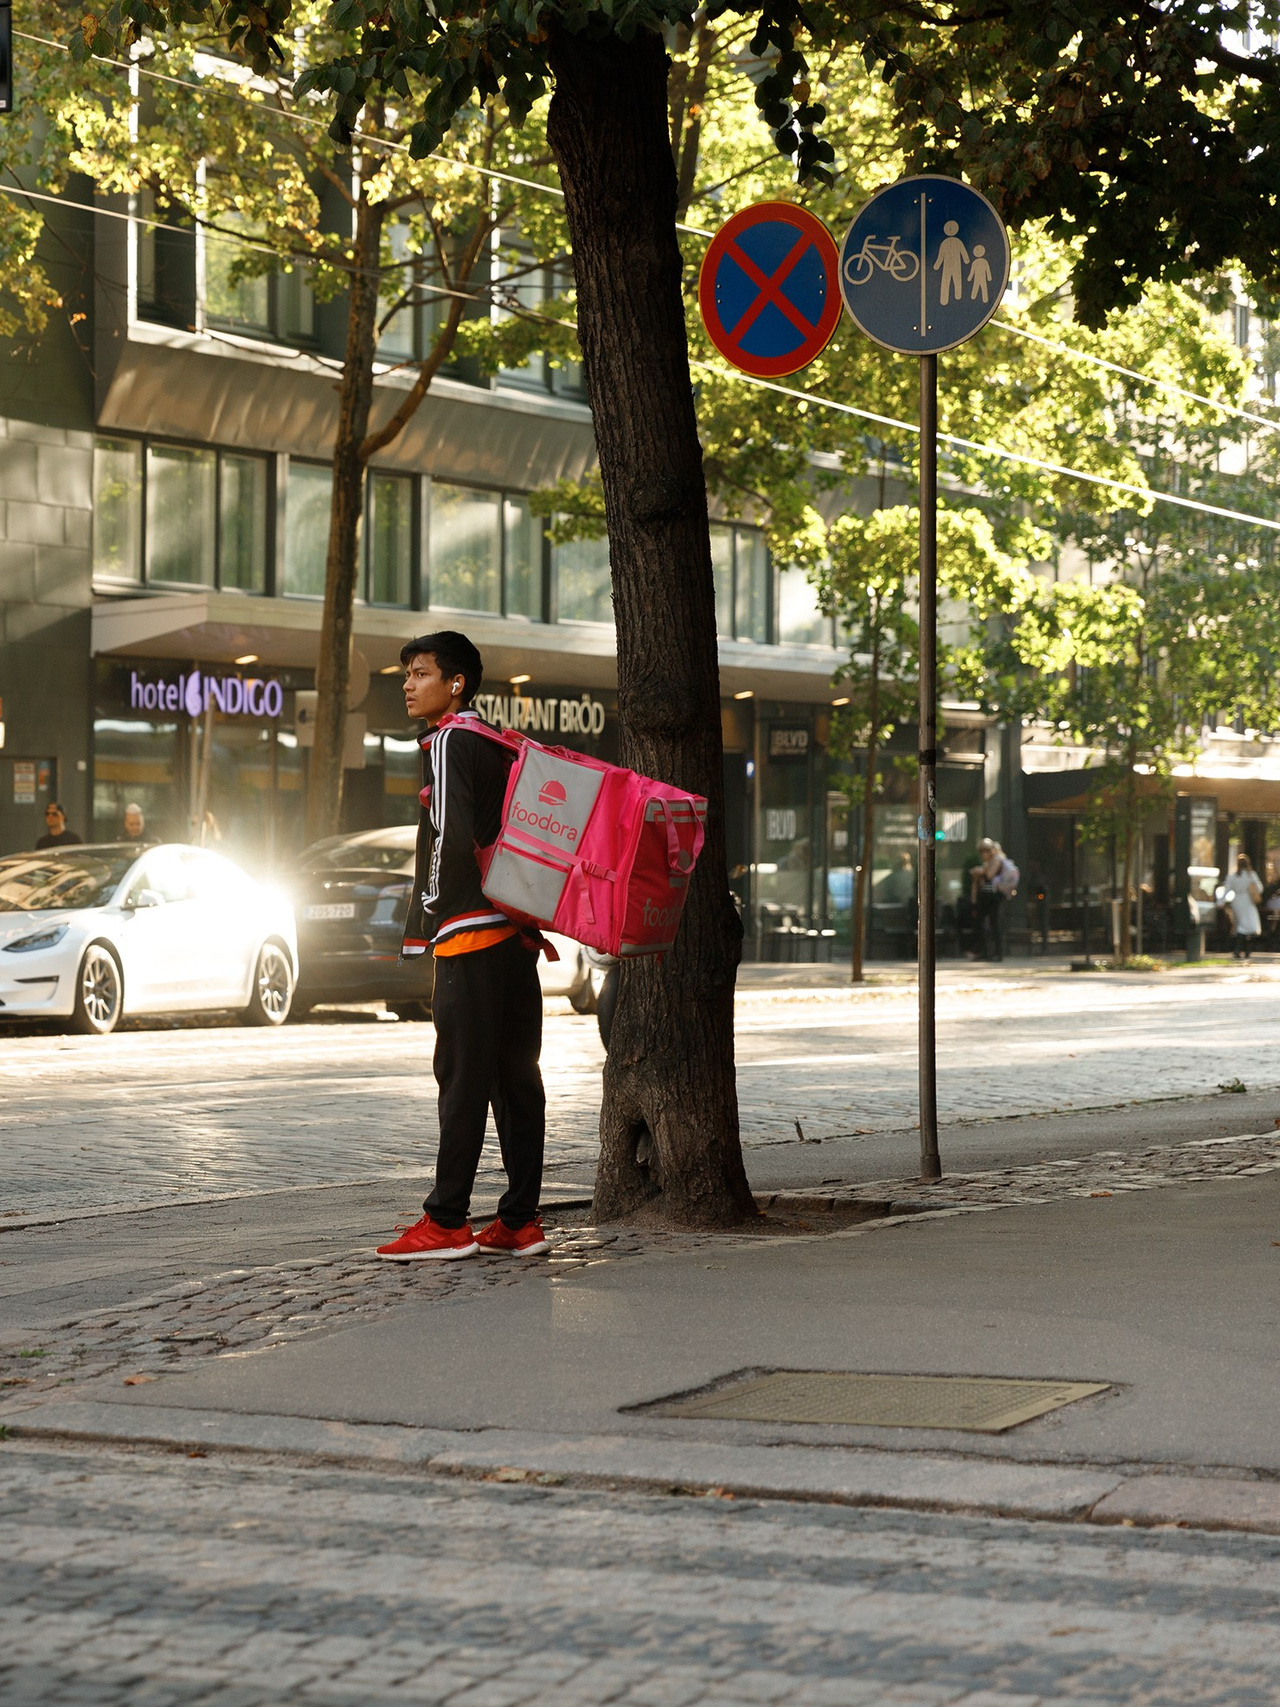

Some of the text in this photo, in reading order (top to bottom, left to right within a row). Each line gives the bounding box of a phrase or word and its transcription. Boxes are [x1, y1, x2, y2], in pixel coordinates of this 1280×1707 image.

[131, 670, 283, 718] hotel INDIGO
[469, 692, 606, 735] STAURANT BRÖD
[511, 801, 578, 842] foodora
